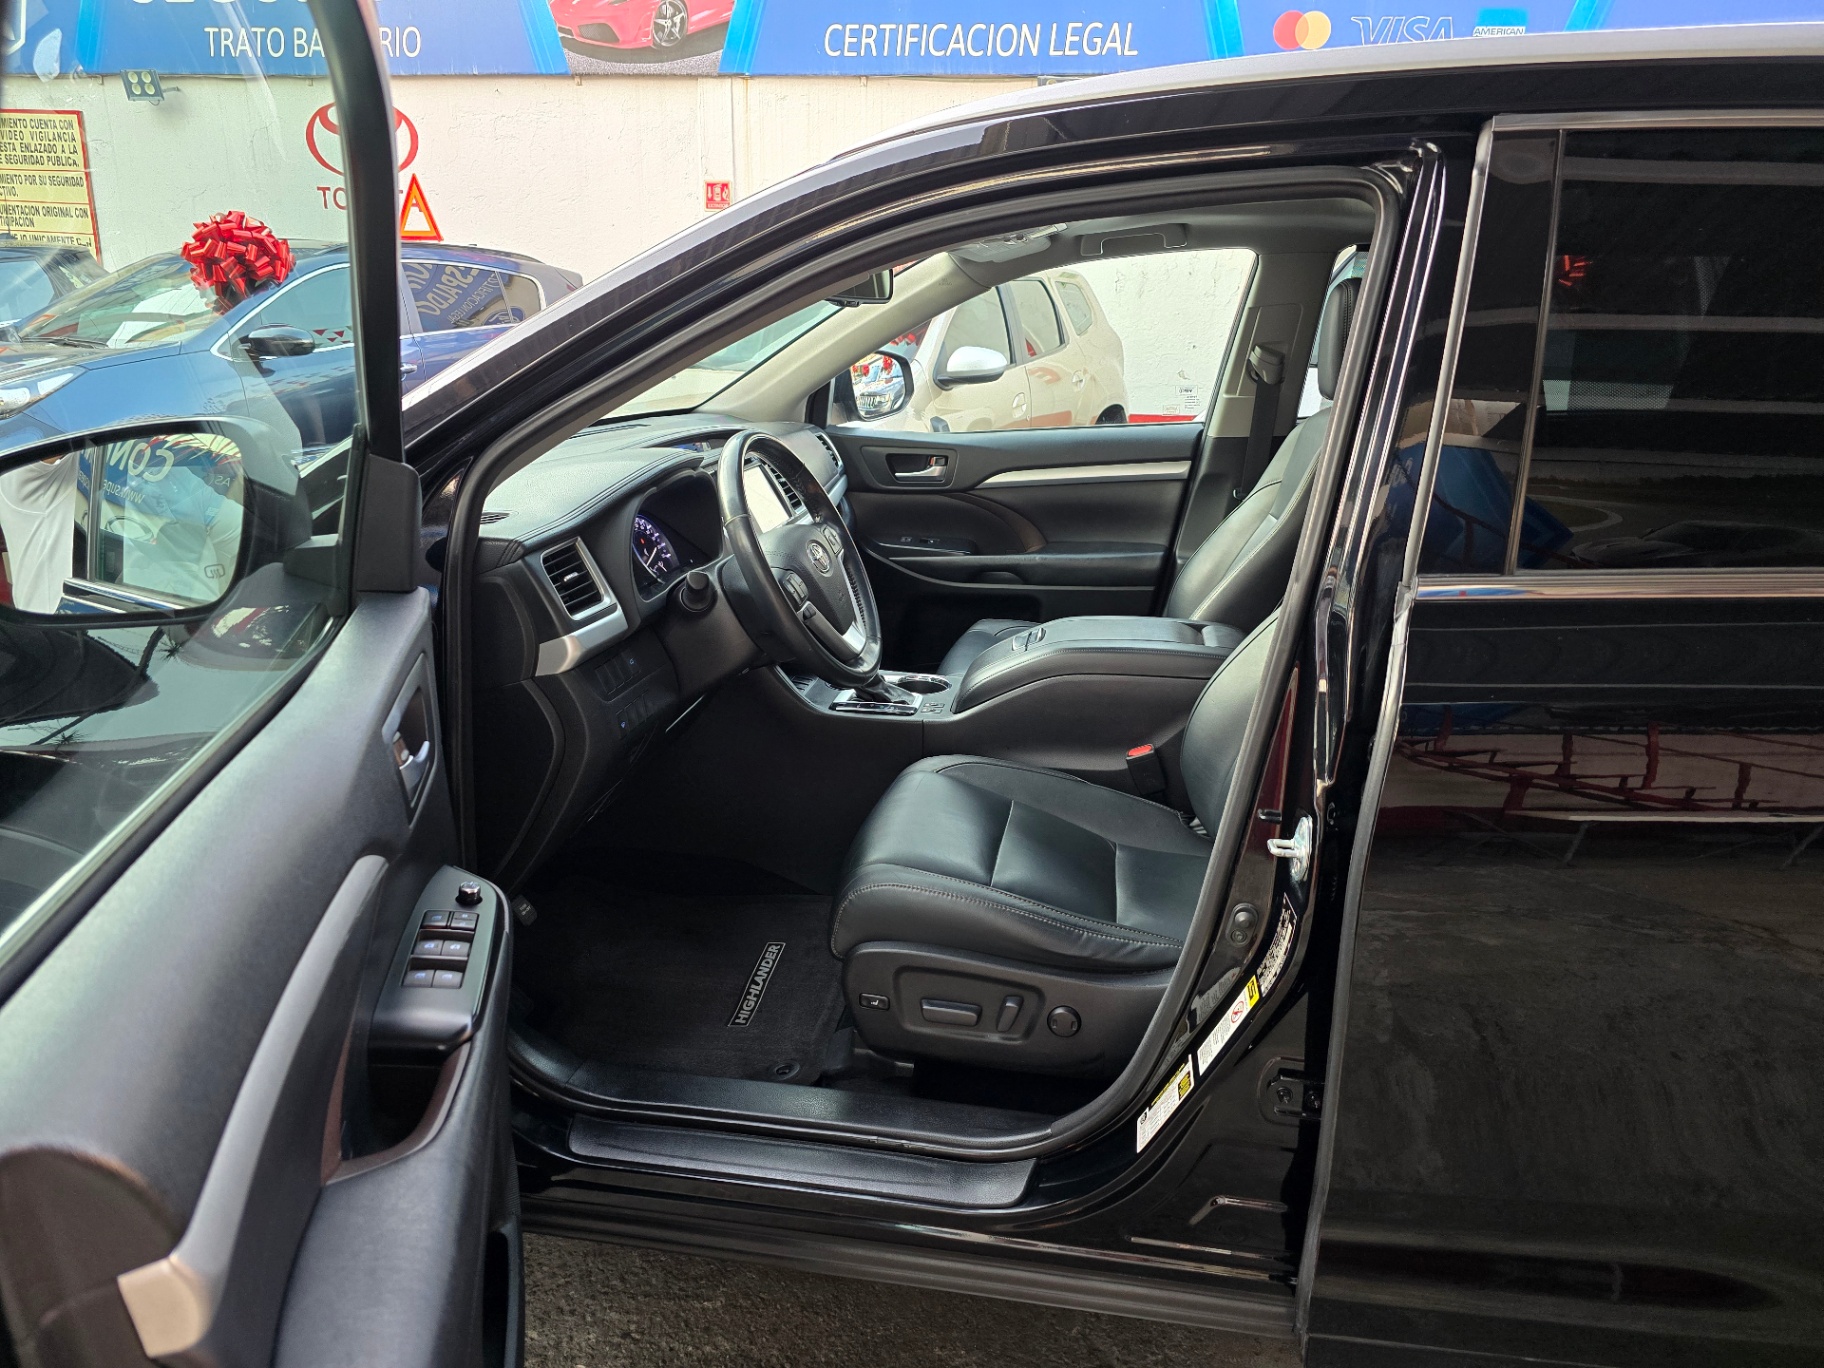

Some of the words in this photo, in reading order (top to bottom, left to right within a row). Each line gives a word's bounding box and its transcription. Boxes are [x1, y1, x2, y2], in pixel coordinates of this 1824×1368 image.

[1350, 16, 1454, 46] VISA
[1473, 26, 1525, 36] AMERICAN
[204, 26, 285, 58] TRATO
[824, 23, 1041, 57] CERTIFICACION
[1048, 22, 1139, 57] LEGAL
[29, 118, 58, 131] CUENTA
[59, 119, 75, 131] CON
[29, 130, 77, 143] VIGILANCIA
[20, 142, 58, 155] ENLAZADO
[61, 144, 67, 155] A
[68, 144, 79, 156] LA
[4, 153, 45, 166] SEGURIDAD
[24, 174, 38, 186] POR
[38, 174, 47, 187] SU
[47, 175, 85, 188] SEGURIDAD
[42, 206, 74, 218] ORIGINAL
[74, 207, 89, 219] CON
[734, 944, 781, 1024] HIGHLANDER
